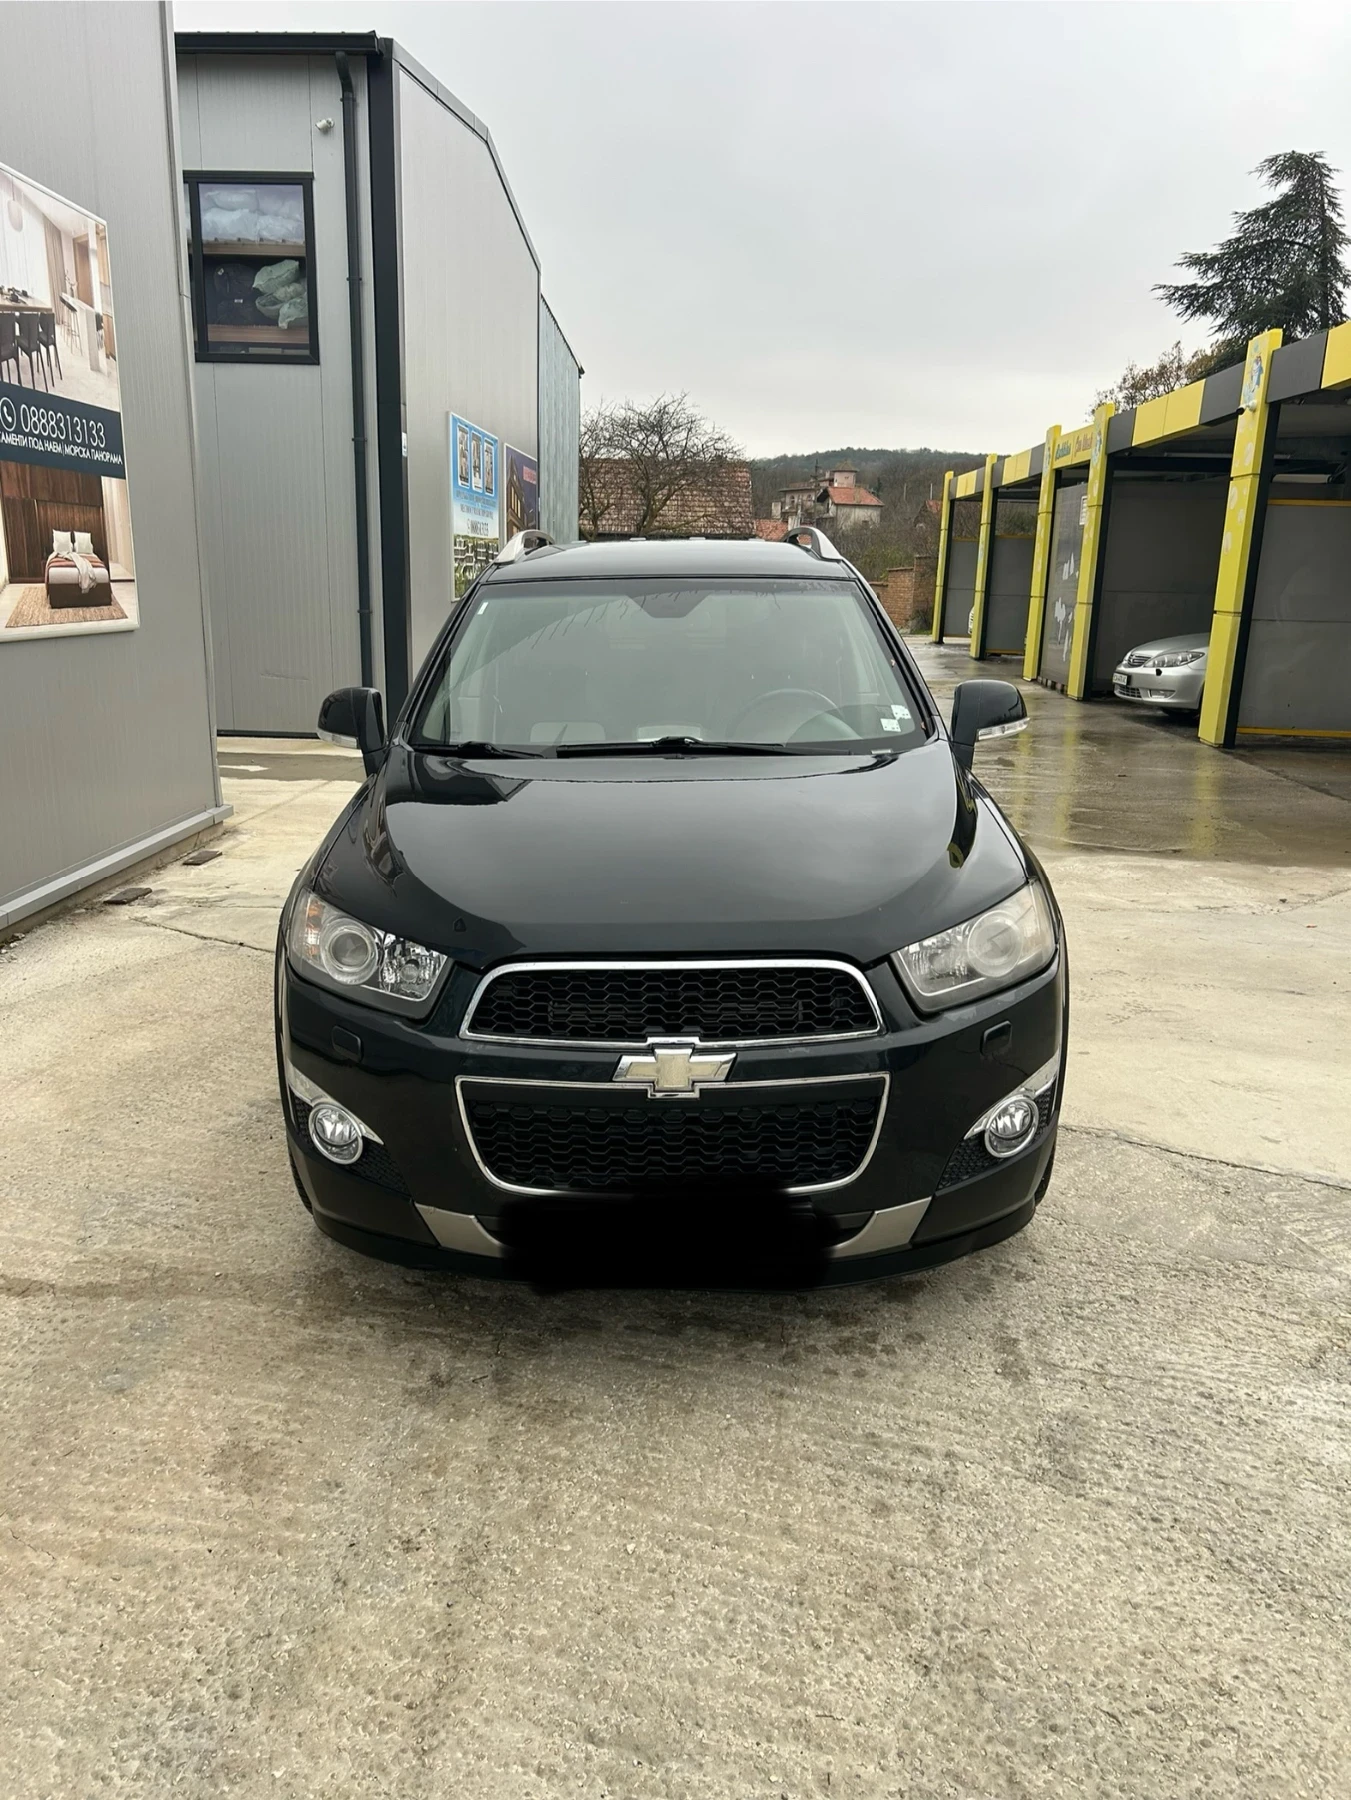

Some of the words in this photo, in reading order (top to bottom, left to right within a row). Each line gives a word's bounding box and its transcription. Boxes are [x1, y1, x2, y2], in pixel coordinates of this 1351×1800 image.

[20, 404, 105, 448] 0888313133
[28, 437, 45, 452] ПОД
[45, 439, 62, 454] НАЕМ
[64, 443, 91, 459] МОРСКА
[91, 450, 123, 465] ПАНОРАМА
